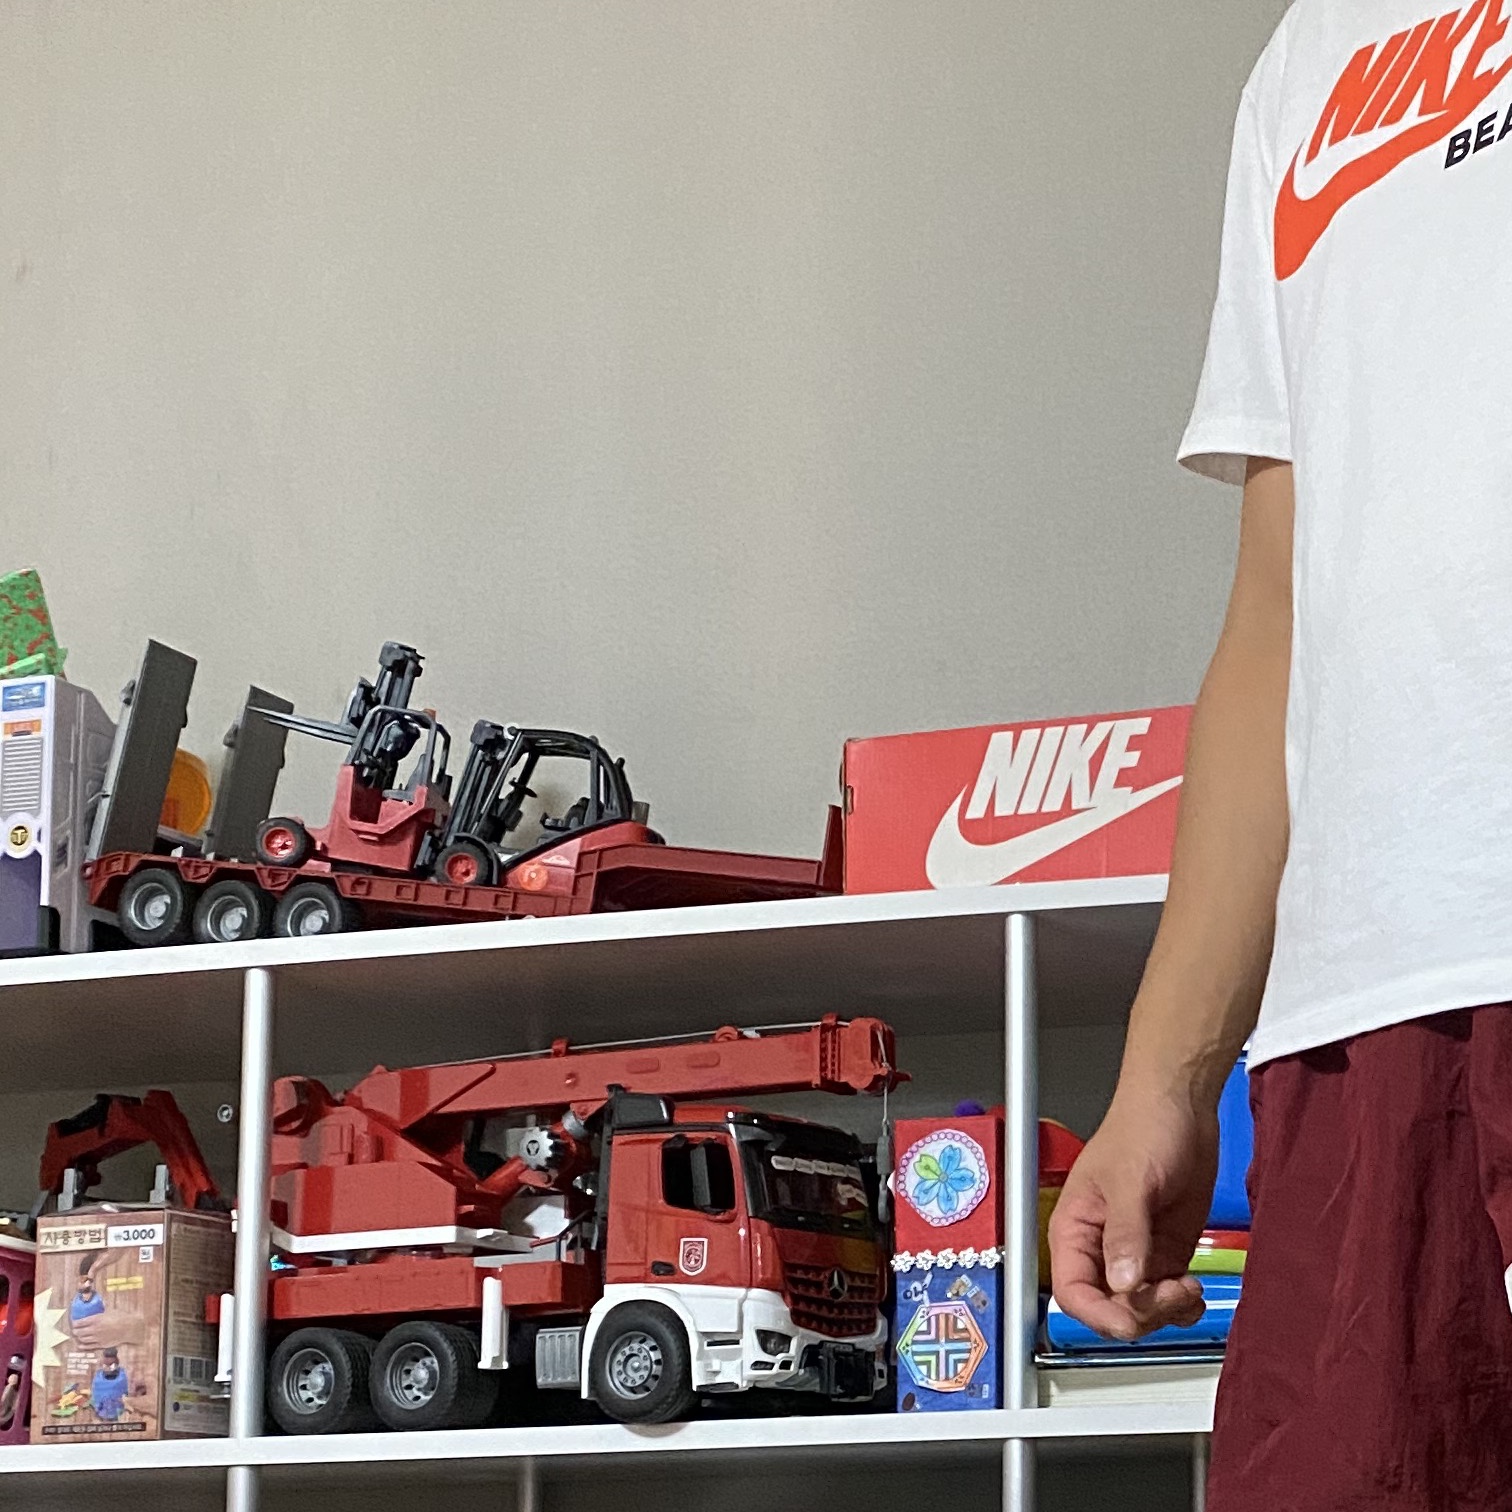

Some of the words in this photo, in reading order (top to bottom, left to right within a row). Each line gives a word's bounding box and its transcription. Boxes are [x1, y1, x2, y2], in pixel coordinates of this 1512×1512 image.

[1303, 0, 1512, 167] NIKE
[964, 716, 1153, 820] NIKE
[44, 1228, 103, 1246] 사용방법
